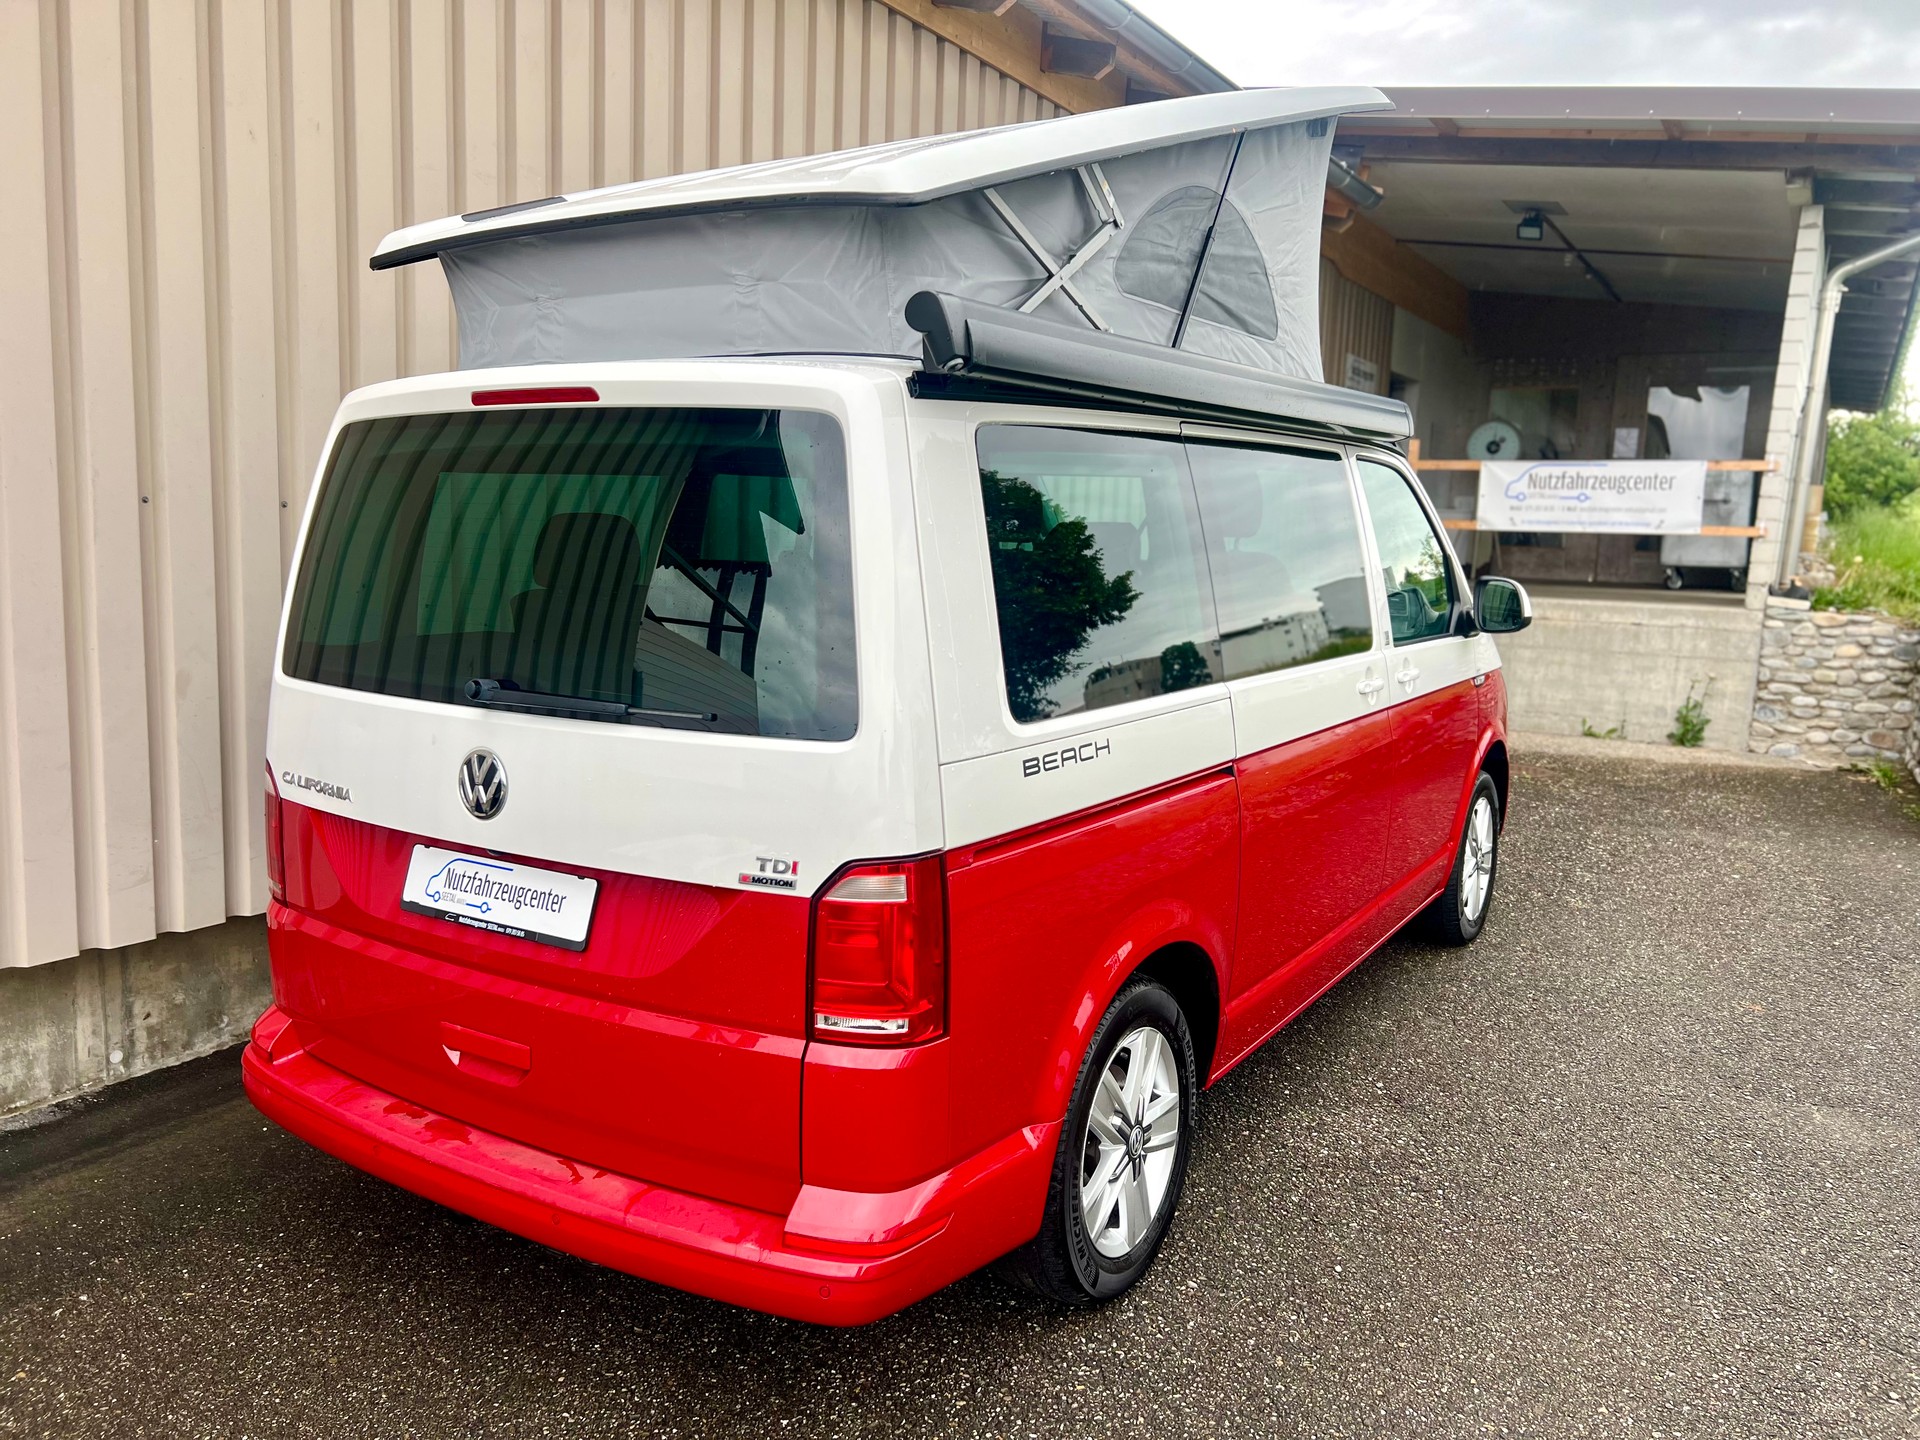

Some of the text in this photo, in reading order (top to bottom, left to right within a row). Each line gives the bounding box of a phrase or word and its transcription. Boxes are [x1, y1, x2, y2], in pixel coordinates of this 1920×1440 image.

[1527, 471, 1676, 494] Nutzfahrzeugcenter
[1022, 738, 1110, 777] BEACH
[282, 770, 353, 803] CALIFORNIA
[459, 751, 507, 817] VW
[756, 856, 799, 875] TDI
[443, 867, 567, 914] Nutzfahrzeugcenter
[1071, 1165, 1087, 1260] MICHELIN
